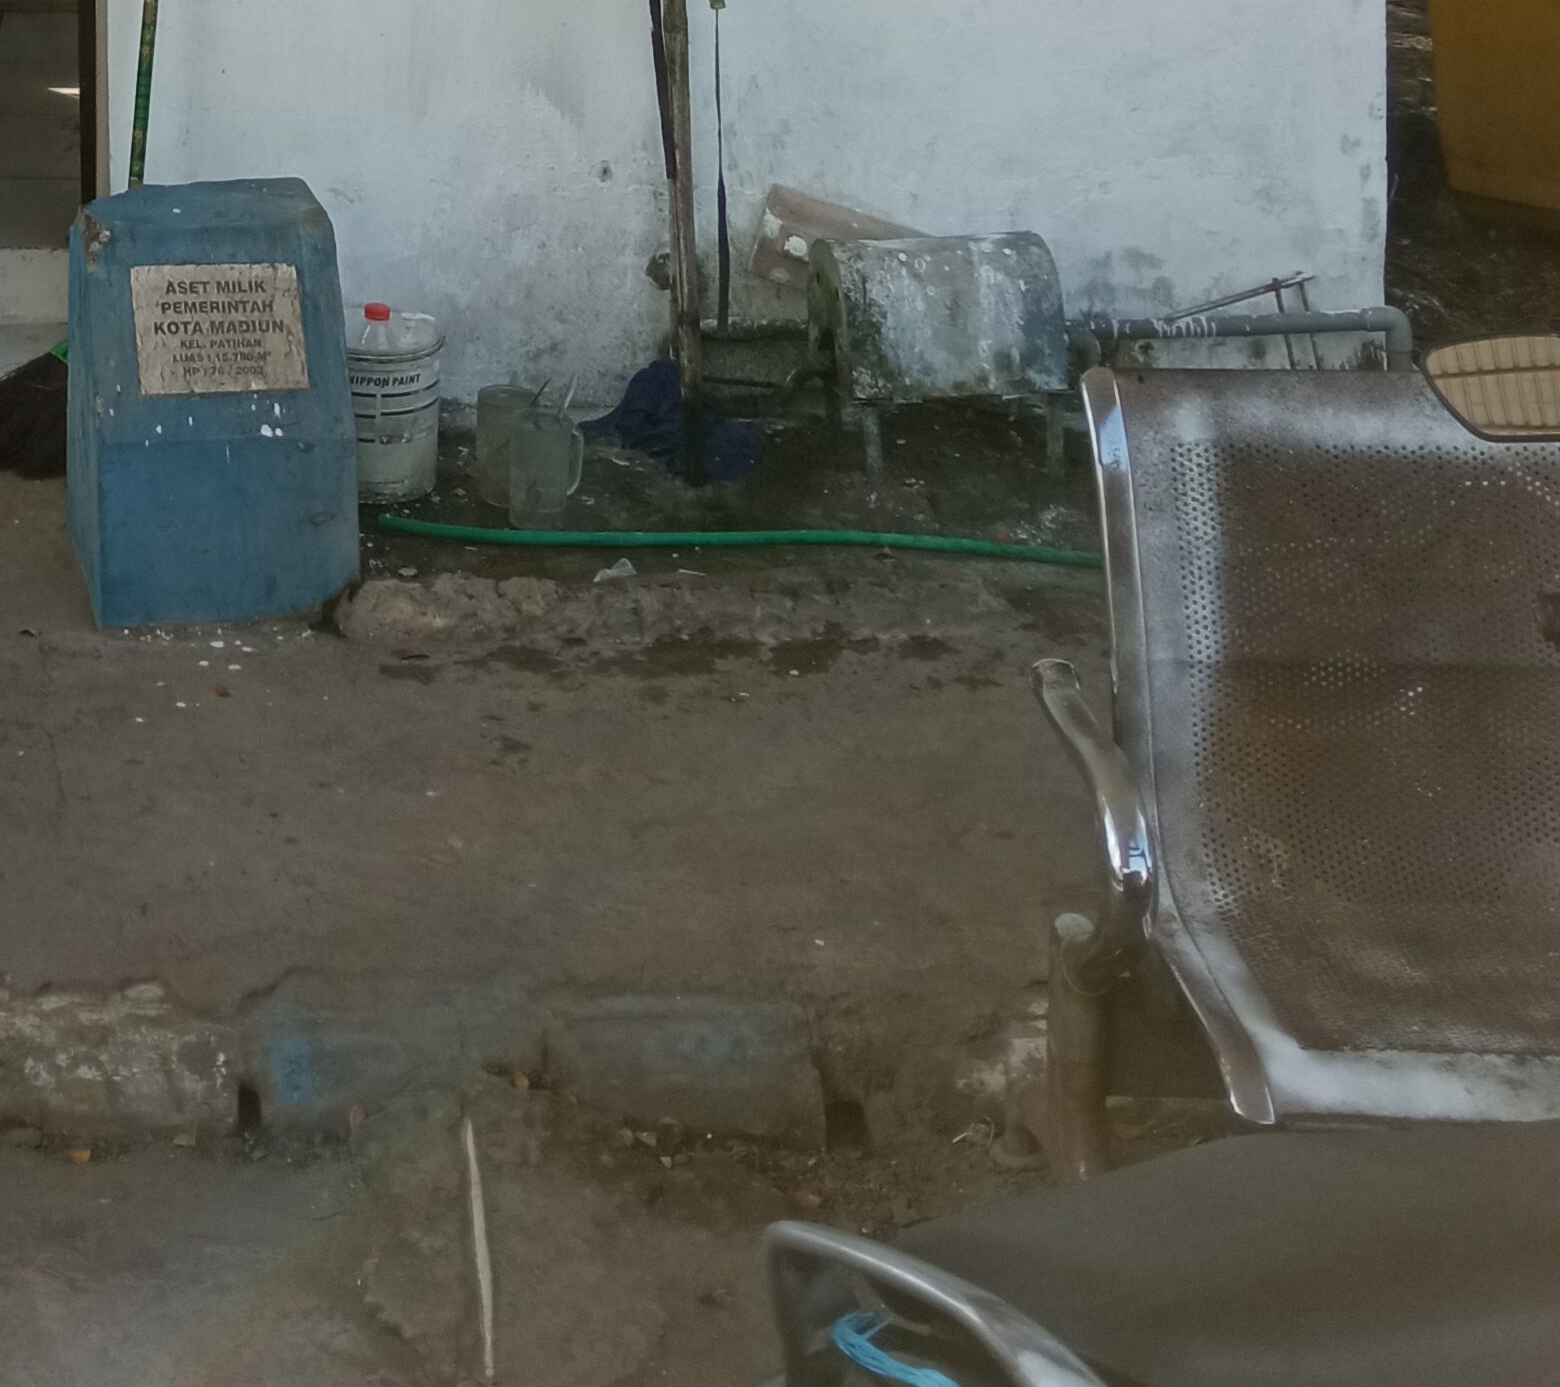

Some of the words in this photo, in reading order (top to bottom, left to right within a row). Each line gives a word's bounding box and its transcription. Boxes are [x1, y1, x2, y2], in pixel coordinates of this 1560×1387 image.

[165, 280, 211, 295] ASET
[216, 279, 267, 294] MILIK
[160, 300, 274, 315] PEMERINTAH
[153, 321, 204, 336] KOTA
[210, 319, 285, 335] MADIUN
[180, 339, 207, 349] KEL.
[210, 338, 262, 349] PATIHAN
[172, 352, 204, 363] LUAS
[349, 376, 390, 389] NIPPON
[391, 372, 422, 387] PAINT
